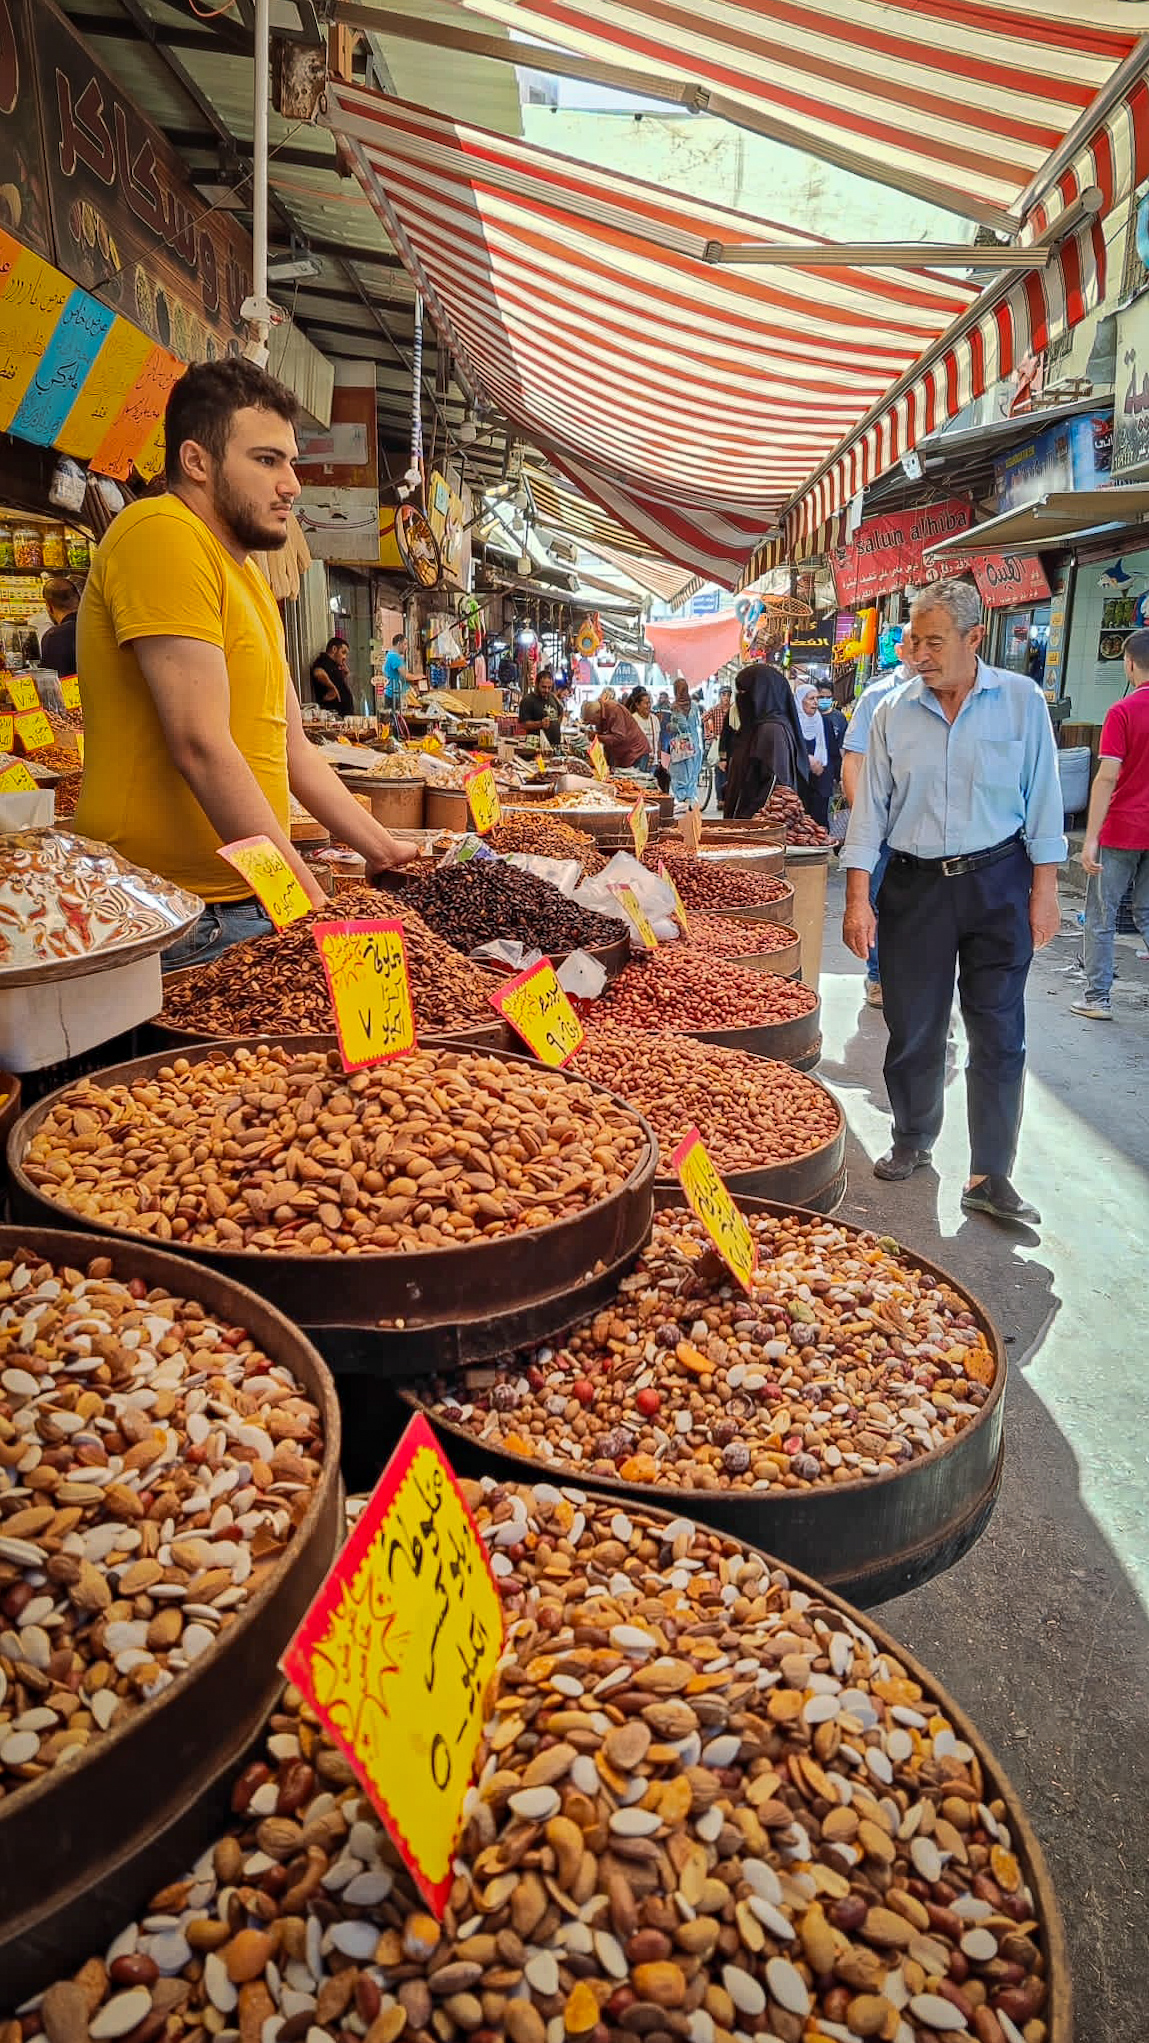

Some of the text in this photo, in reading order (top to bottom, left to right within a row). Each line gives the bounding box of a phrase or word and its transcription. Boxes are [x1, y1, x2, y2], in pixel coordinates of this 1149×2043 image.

[855, 510, 967, 555] salun alhiba
[357, 1006, 372, 1041] ٧
[545, 1030, 568, 1057] ٩
